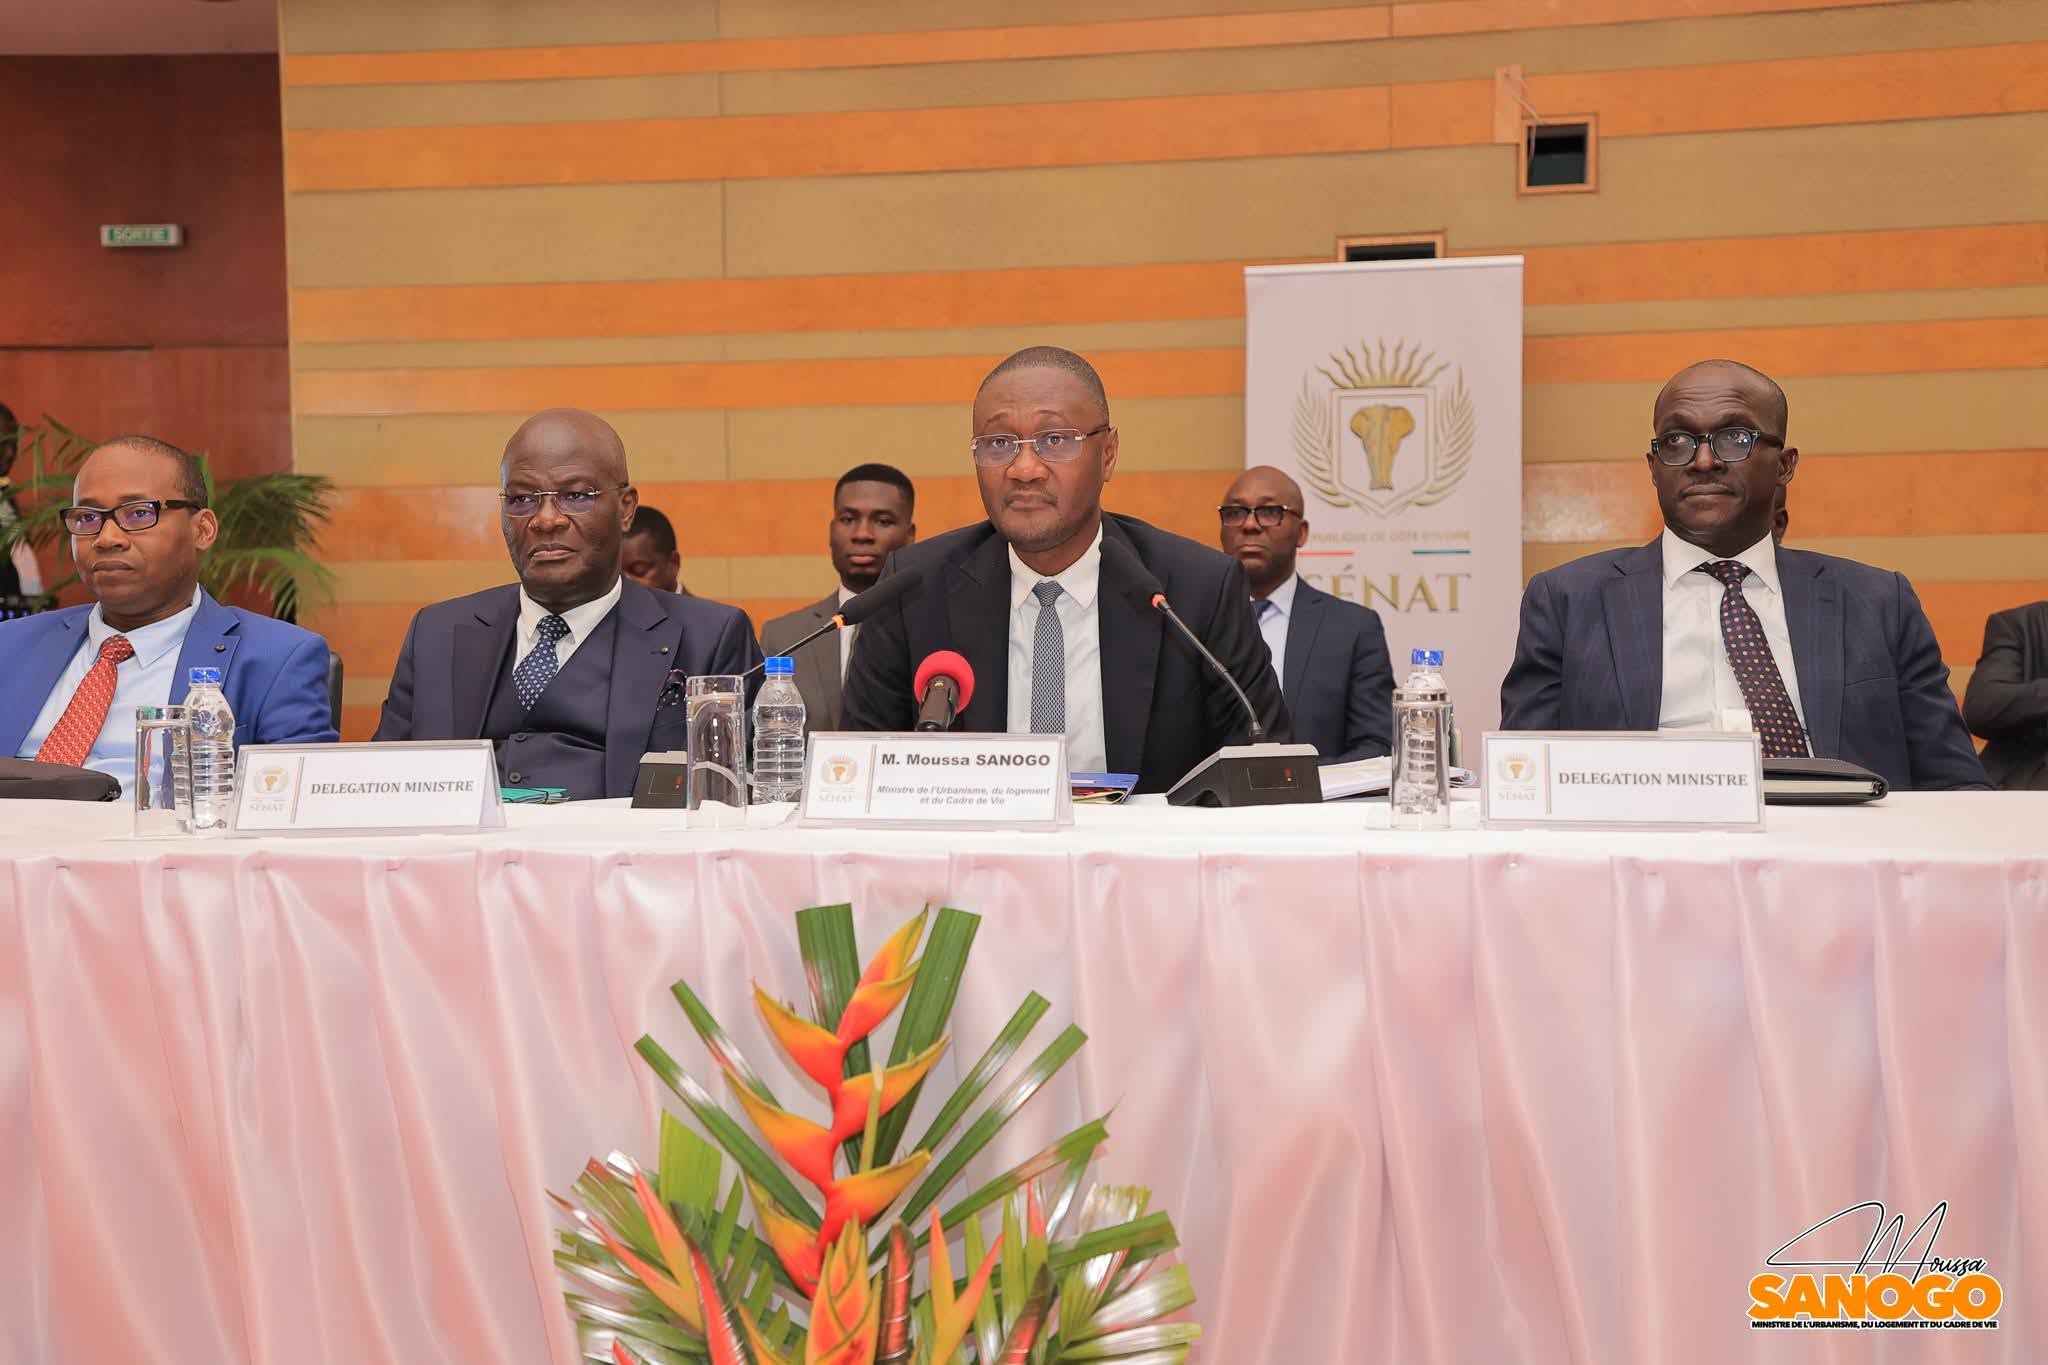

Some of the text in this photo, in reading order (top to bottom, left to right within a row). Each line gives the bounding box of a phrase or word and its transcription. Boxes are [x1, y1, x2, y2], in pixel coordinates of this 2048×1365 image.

[881, 753, 1051, 767] M. Moussa SANOGO
[1558, 771, 1749, 787] DELEGATION MINISTRE
[311, 780, 475, 795] DELEGATION MINISTRE
[877, 785, 915, 795] Ministre
[916, 785, 929, 795] de
[991, 785, 1004, 796] du
[1006, 785, 1051, 797] logement
[919, 796, 1006, 806] et du Cadre de Vie
